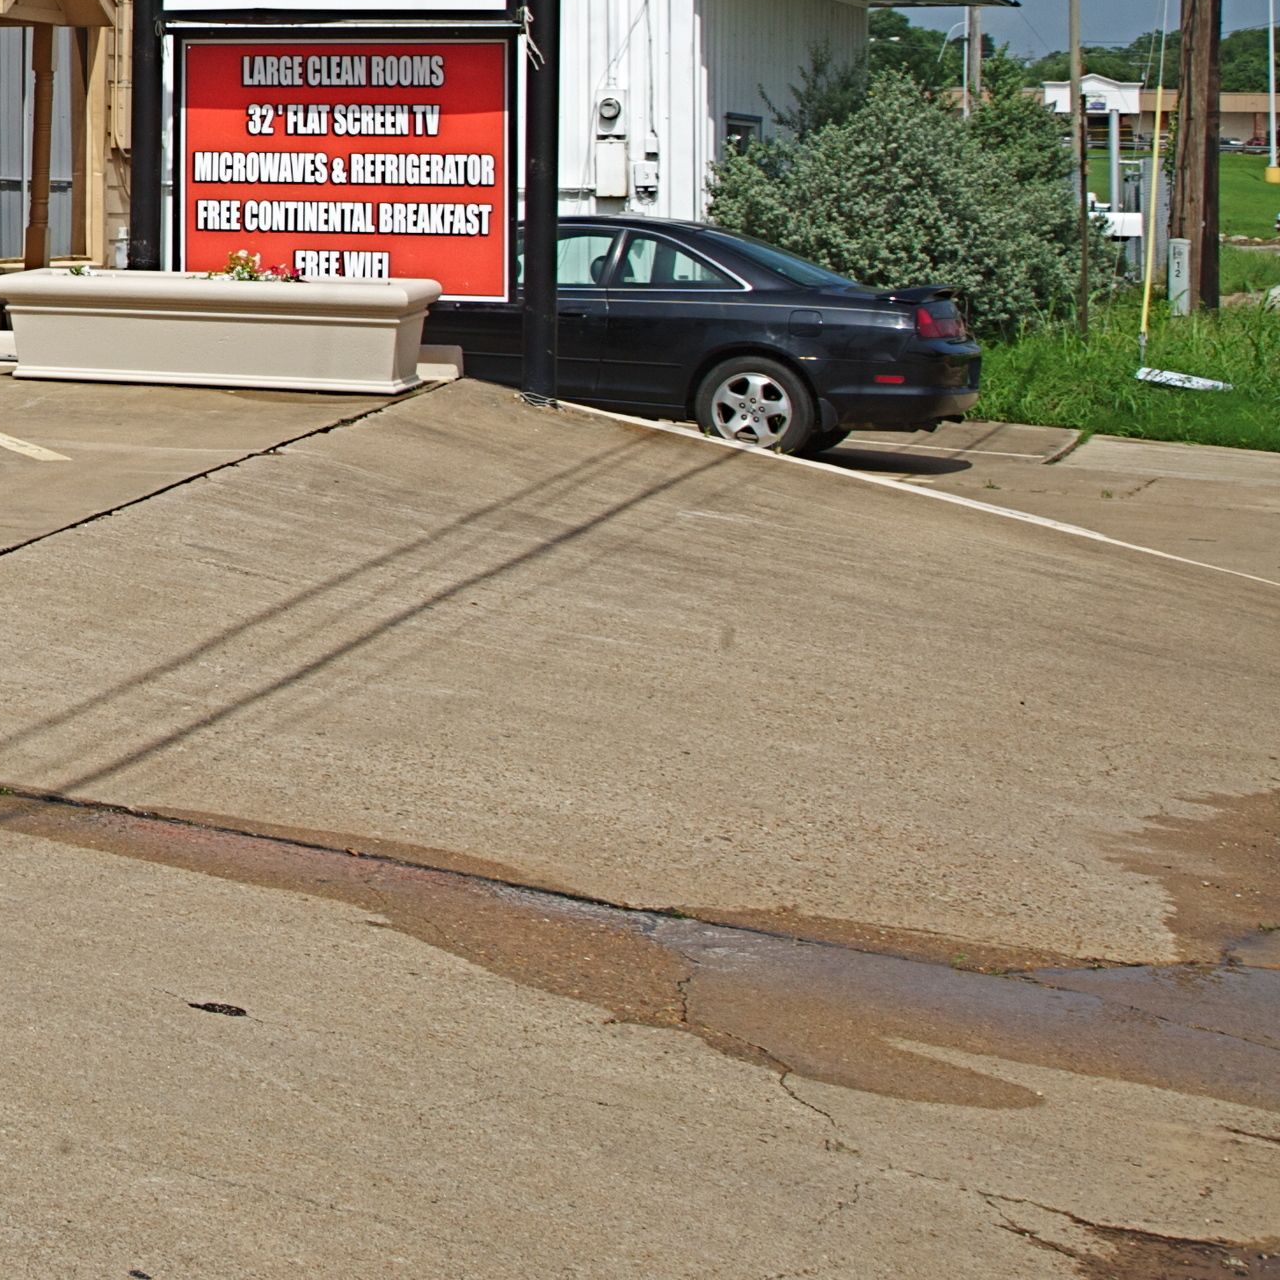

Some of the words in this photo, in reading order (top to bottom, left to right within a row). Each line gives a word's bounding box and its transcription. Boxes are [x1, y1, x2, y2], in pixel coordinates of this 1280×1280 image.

[243, 55, 303, 86] LARGE
[307, 55, 366, 86] CLEAN
[371, 55, 444, 86] ROOMS
[287, 104, 330, 135] FLAT
[333, 104, 409, 136] SCREEN
[412, 105, 440, 136] TV
[194, 151, 328, 184] MICROWAVES
[331, 157, 347, 184] &
[350, 153, 495, 186] REFRIGERATOR
[197, 199, 241, 230] FREE
[244, 200, 375, 233] CONTINENTAL
[378, 202, 493, 236] BREAKFAST
[295, 250, 340, 278] FREE
[342, 250, 390, 278] WIFI
